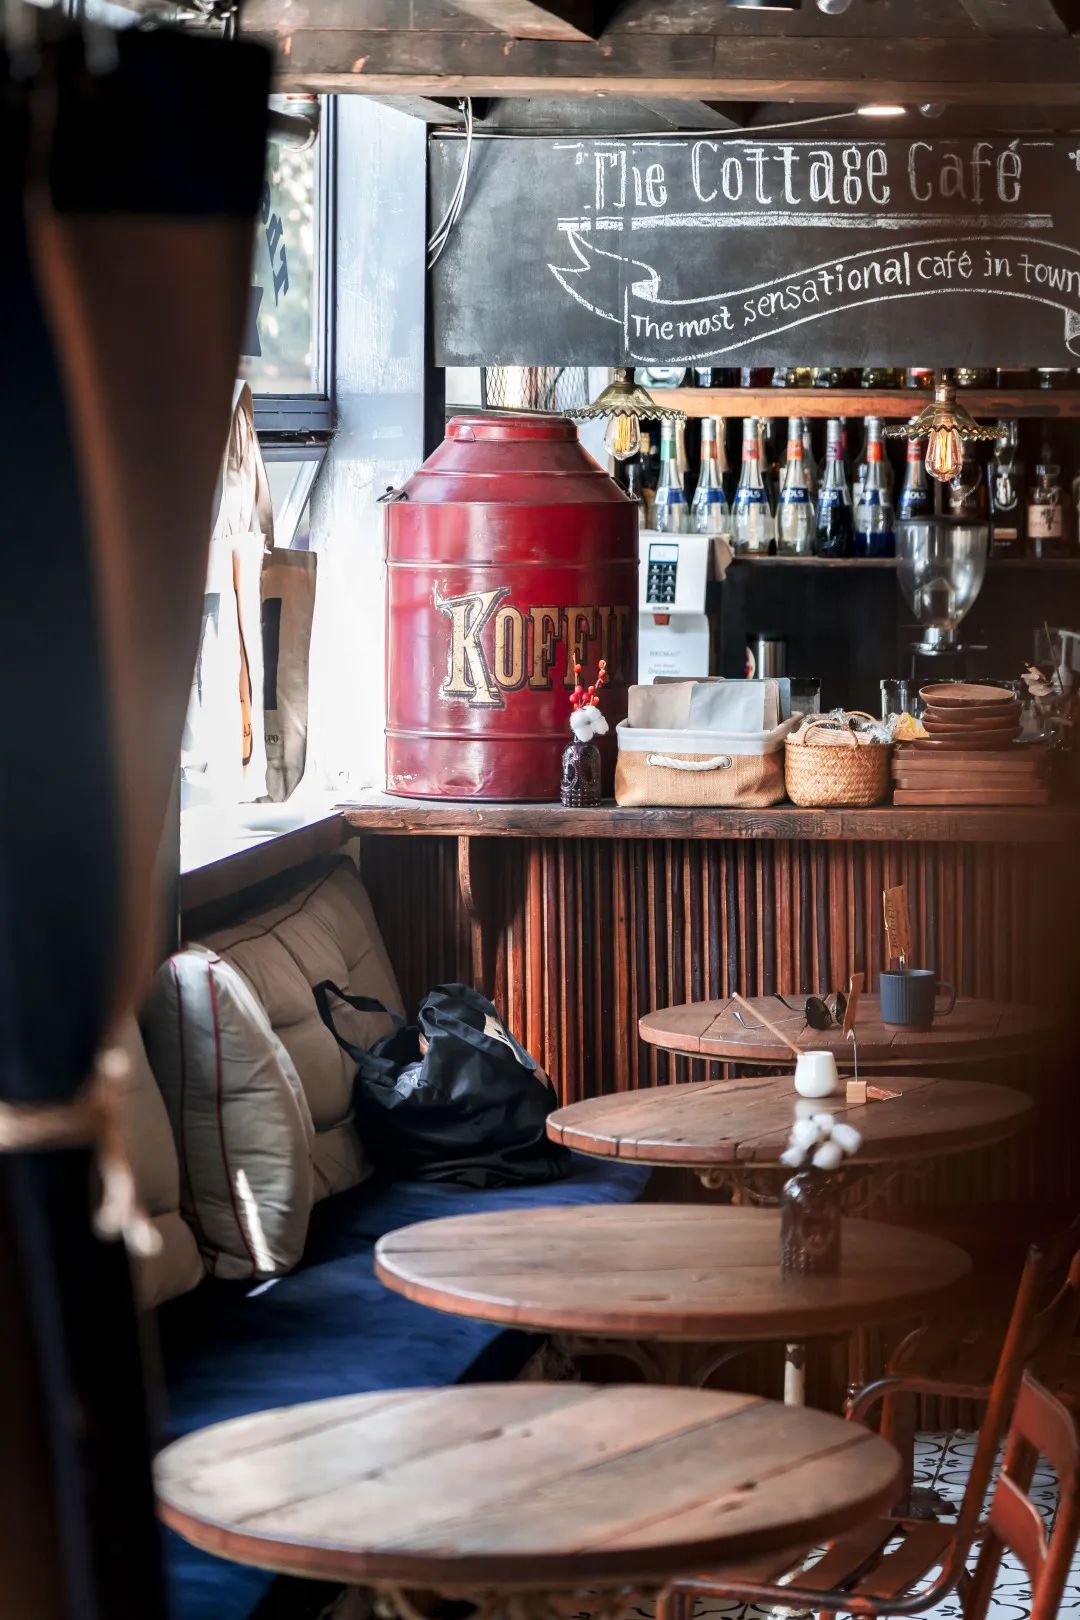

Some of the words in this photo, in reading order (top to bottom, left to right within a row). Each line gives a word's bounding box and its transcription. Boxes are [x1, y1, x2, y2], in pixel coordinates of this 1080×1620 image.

[593, 149, 668, 210] The
[691, 140, 891, 205] Cottage
[907, 138, 1022, 205] Café
[630, 314, 674, 340] The
[677, 305, 735, 338] most
[743, 251, 911, 327] sensational
[916, 250, 974, 280] café
[983, 249, 1013, 278] in
[1017, 254, 1080, 298] town
